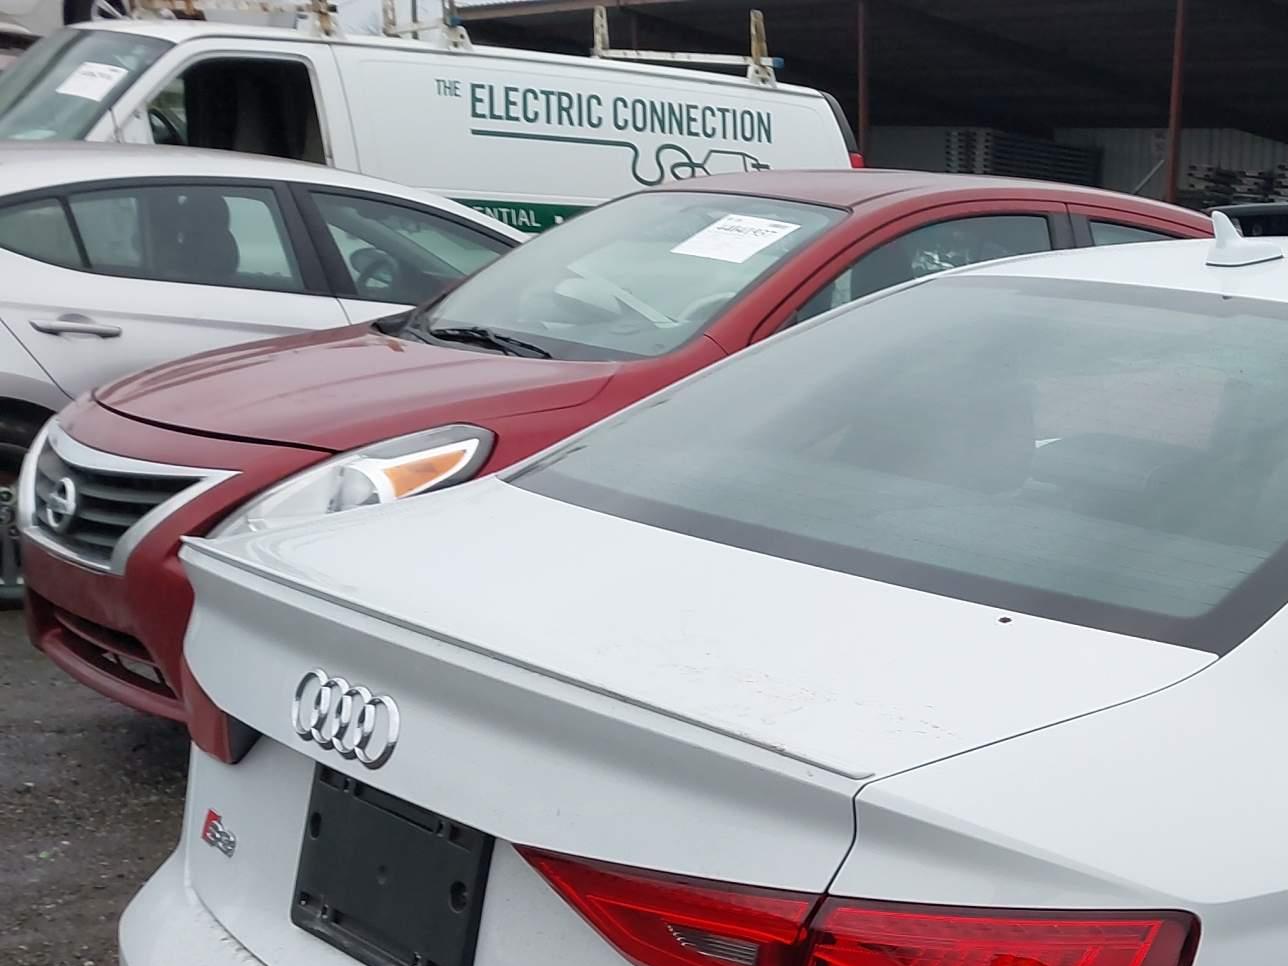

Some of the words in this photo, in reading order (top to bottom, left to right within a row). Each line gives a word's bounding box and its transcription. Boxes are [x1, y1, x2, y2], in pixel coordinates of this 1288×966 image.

[435, 78, 462, 98] THE
[470, 82, 604, 129] ELECTRIC
[612, 96, 773, 145] CONNECTION
[473, 206, 542, 228] NTIAL
